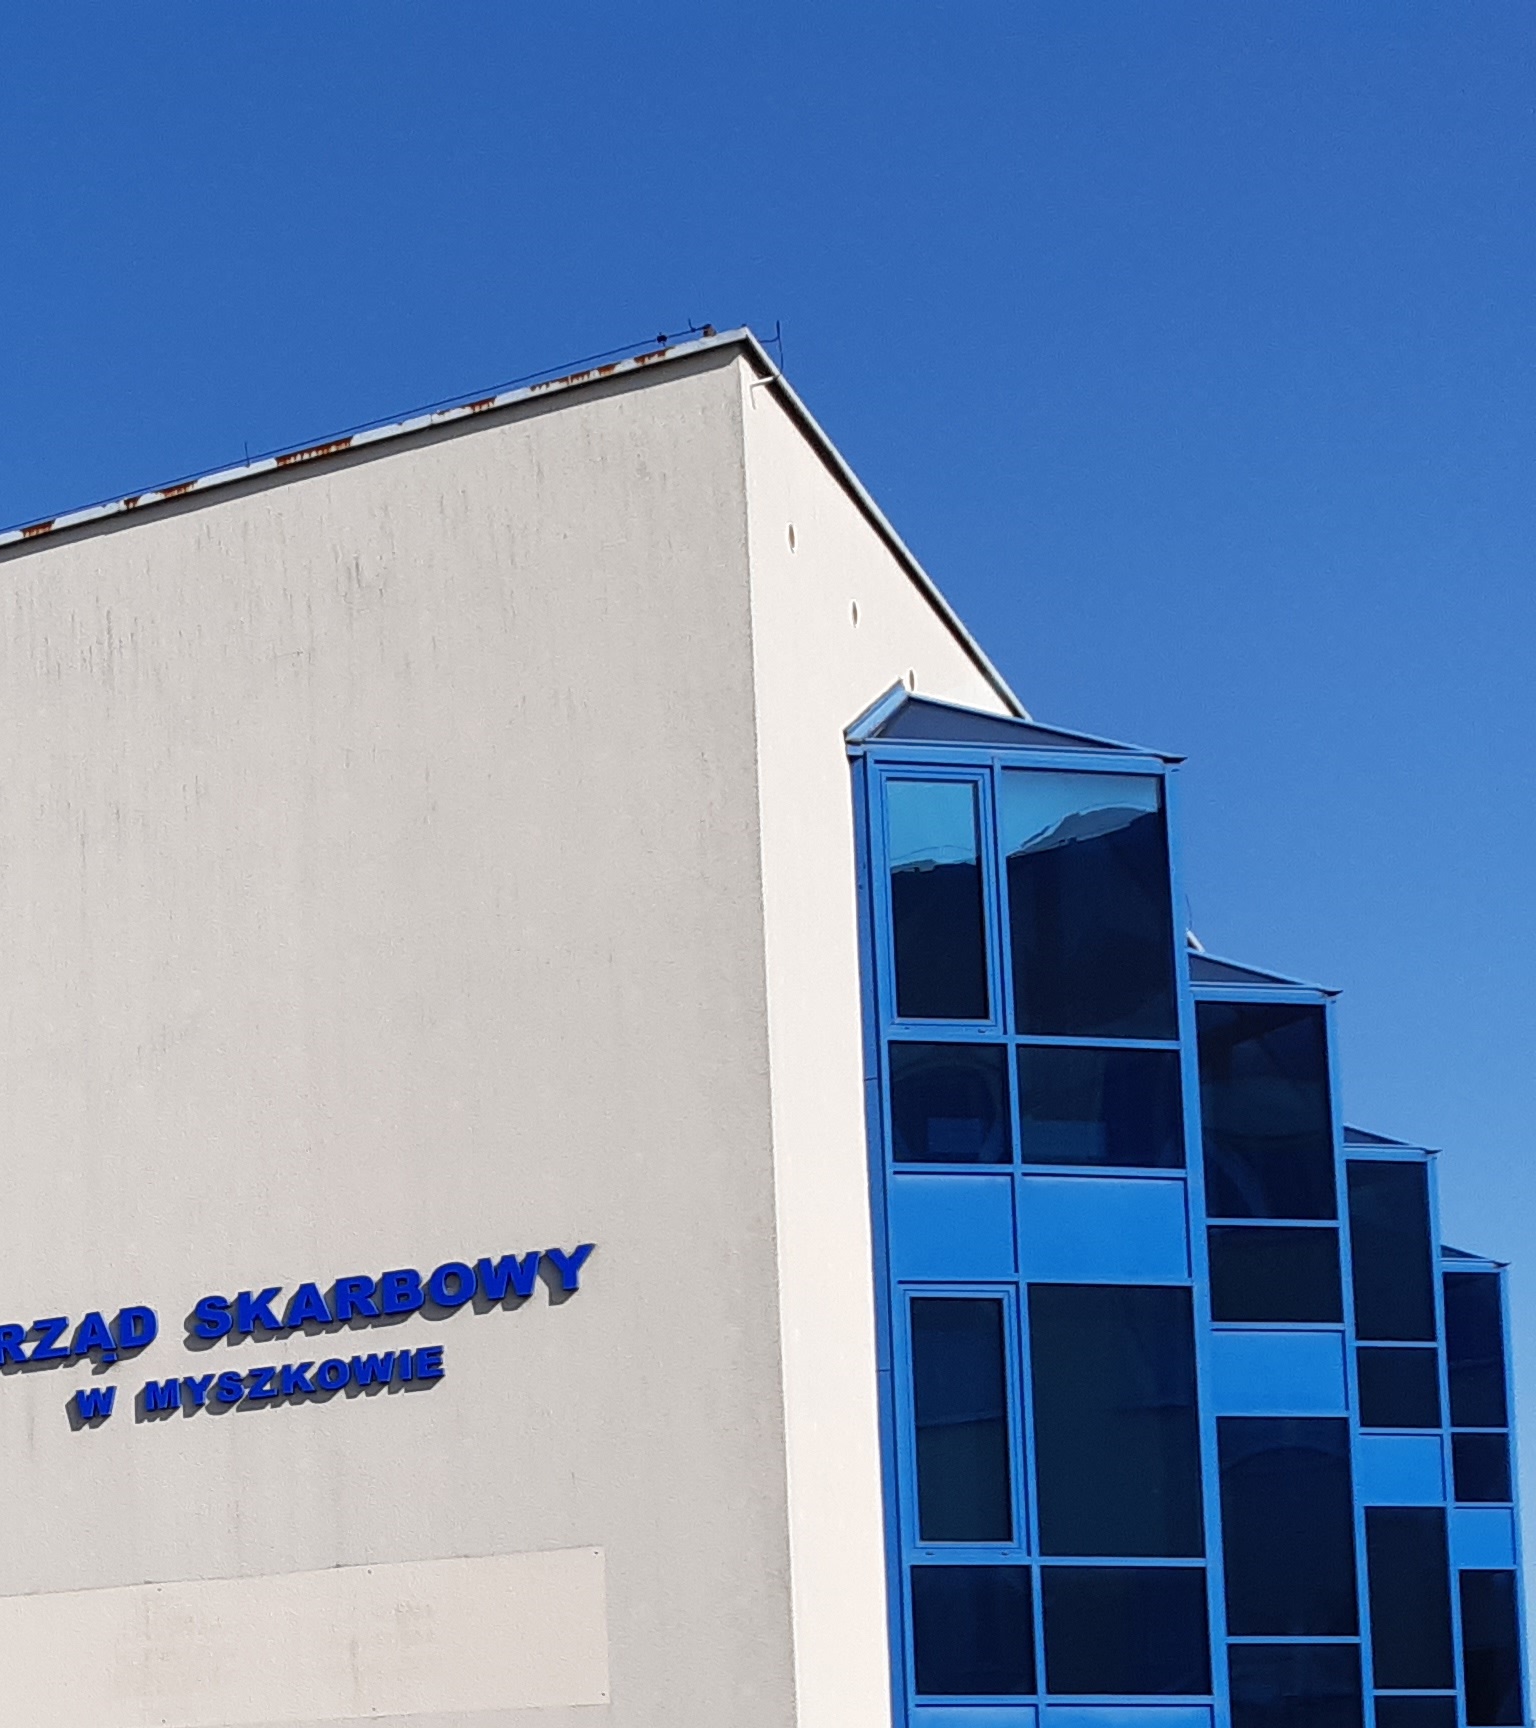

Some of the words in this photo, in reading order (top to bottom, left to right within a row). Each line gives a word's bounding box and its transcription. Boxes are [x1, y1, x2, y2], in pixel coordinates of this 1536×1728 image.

[192, 1243, 595, 1340] SKARBOWY
[74, 1385, 119, 1421] W
[143, 1345, 446, 1412] MYSZKOWIE
